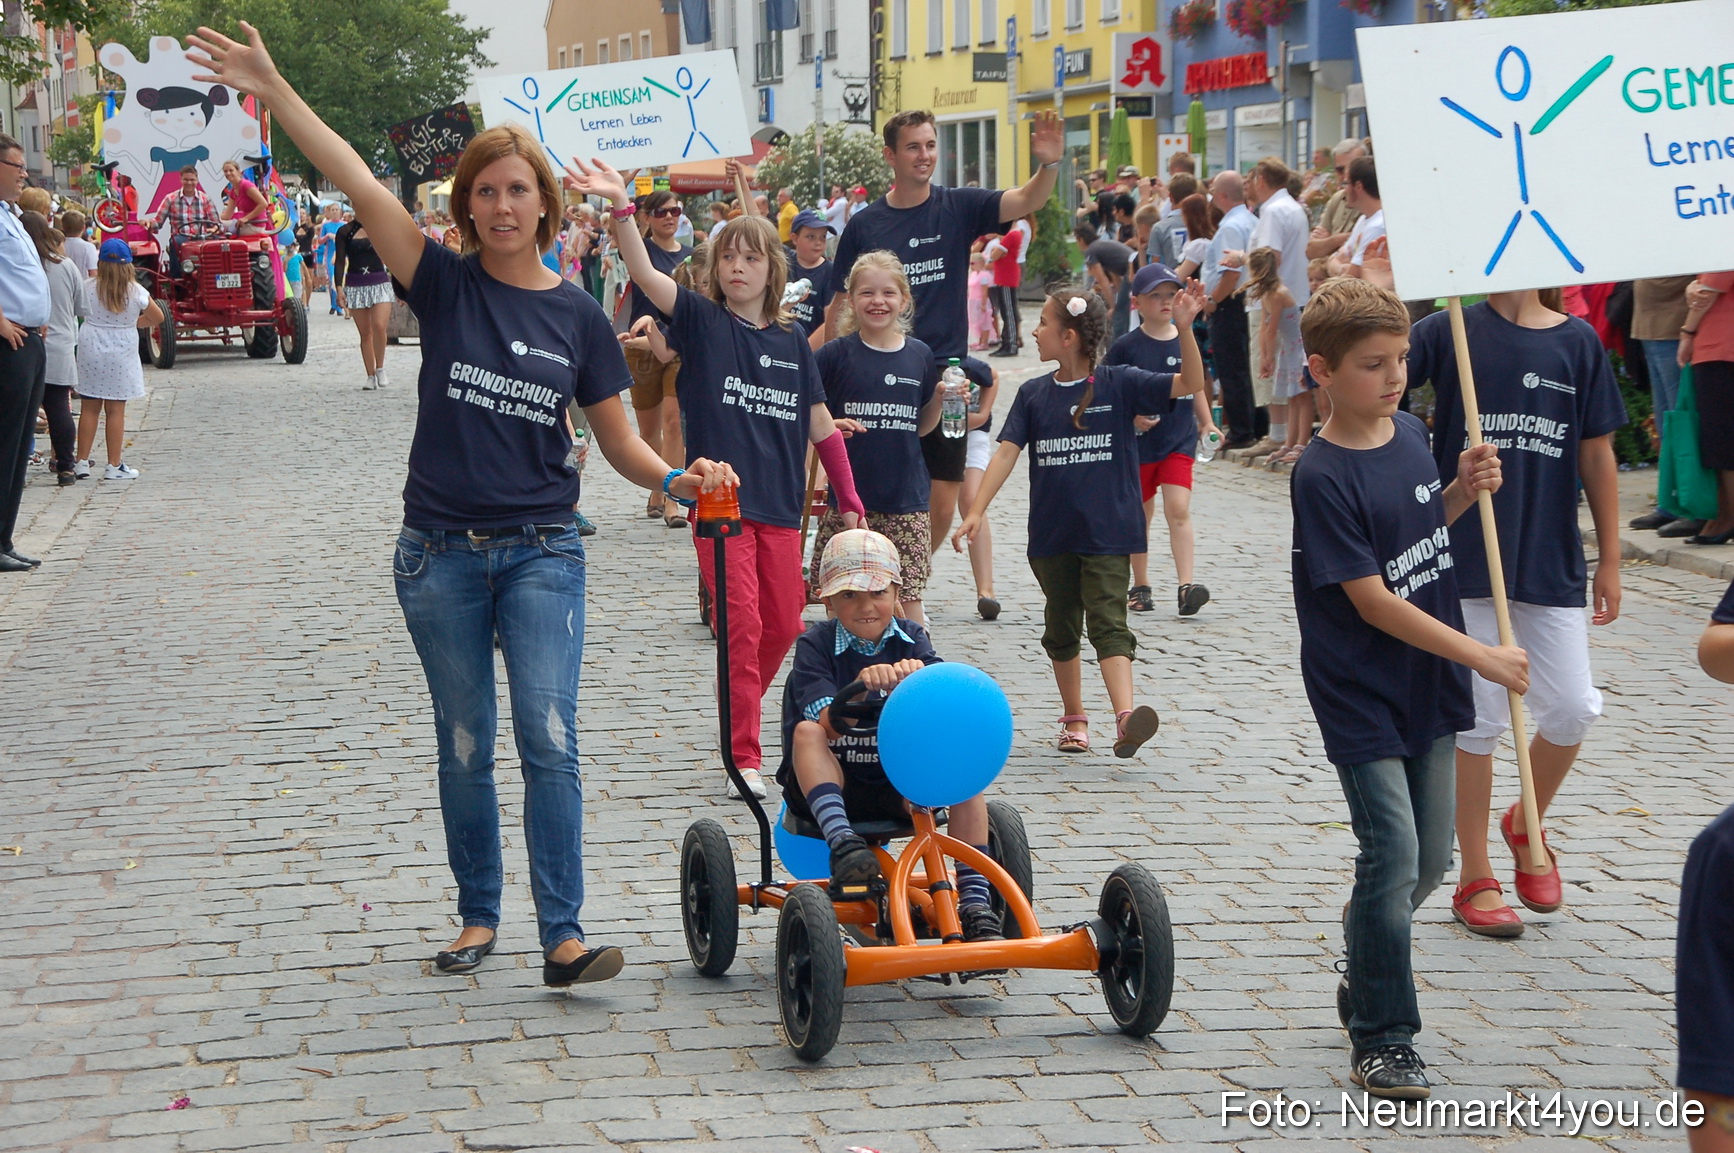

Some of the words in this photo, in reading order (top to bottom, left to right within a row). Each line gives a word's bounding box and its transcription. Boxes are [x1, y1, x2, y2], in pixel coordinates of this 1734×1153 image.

[975, 70, 1007, 79] TAIFU
[1183, 51, 1268, 95] APOTHEKE
[567, 86, 652, 112] GEMEINSAM
[932, 87, 978, 108] Restaurant
[1622, 63, 1734, 114] GEME
[580, 118, 624, 132] Lernen
[630, 113, 662, 126] Leben
[400, 114, 436, 160] MAGIC
[597, 135, 652, 151] Entdecken
[409, 127, 466, 176] BUTTERFL
[1675, 183, 1734, 219] Ent
[903, 257, 944, 275] DSCHULE
[450, 361, 562, 409] GRUNDSCHULE
[447, 383, 462, 400] im
[465, 388, 495, 410] Haus
[497, 400, 556, 427] St.Marien
[722, 392, 736, 405] im
[844, 402, 917, 419] GRUNDSCHULE
[880, 418, 917, 432] St.Marien
[1046, 455, 1068, 466] Haus
[1068, 450, 1112, 464] St.Marien
[1408, 567, 1440, 592] Haus
[846, 749, 879, 763] Haus
